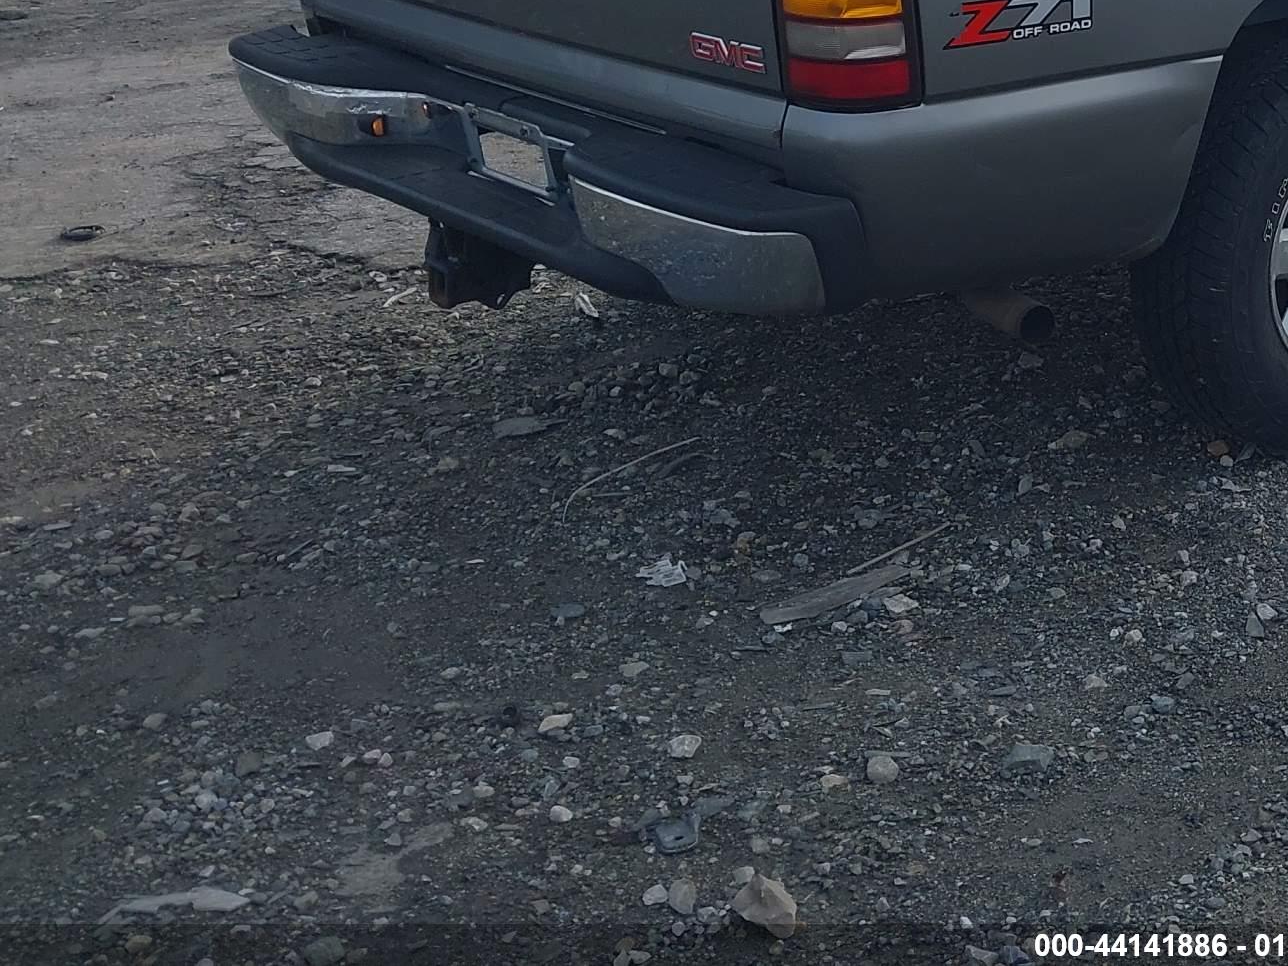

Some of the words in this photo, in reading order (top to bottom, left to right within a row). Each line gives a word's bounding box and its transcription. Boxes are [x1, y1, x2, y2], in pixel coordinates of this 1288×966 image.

[1012, 26, 1043, 40] OFF
[1050, 19, 1093, 34] ROAD
[689, 31, 767, 74] GMC
